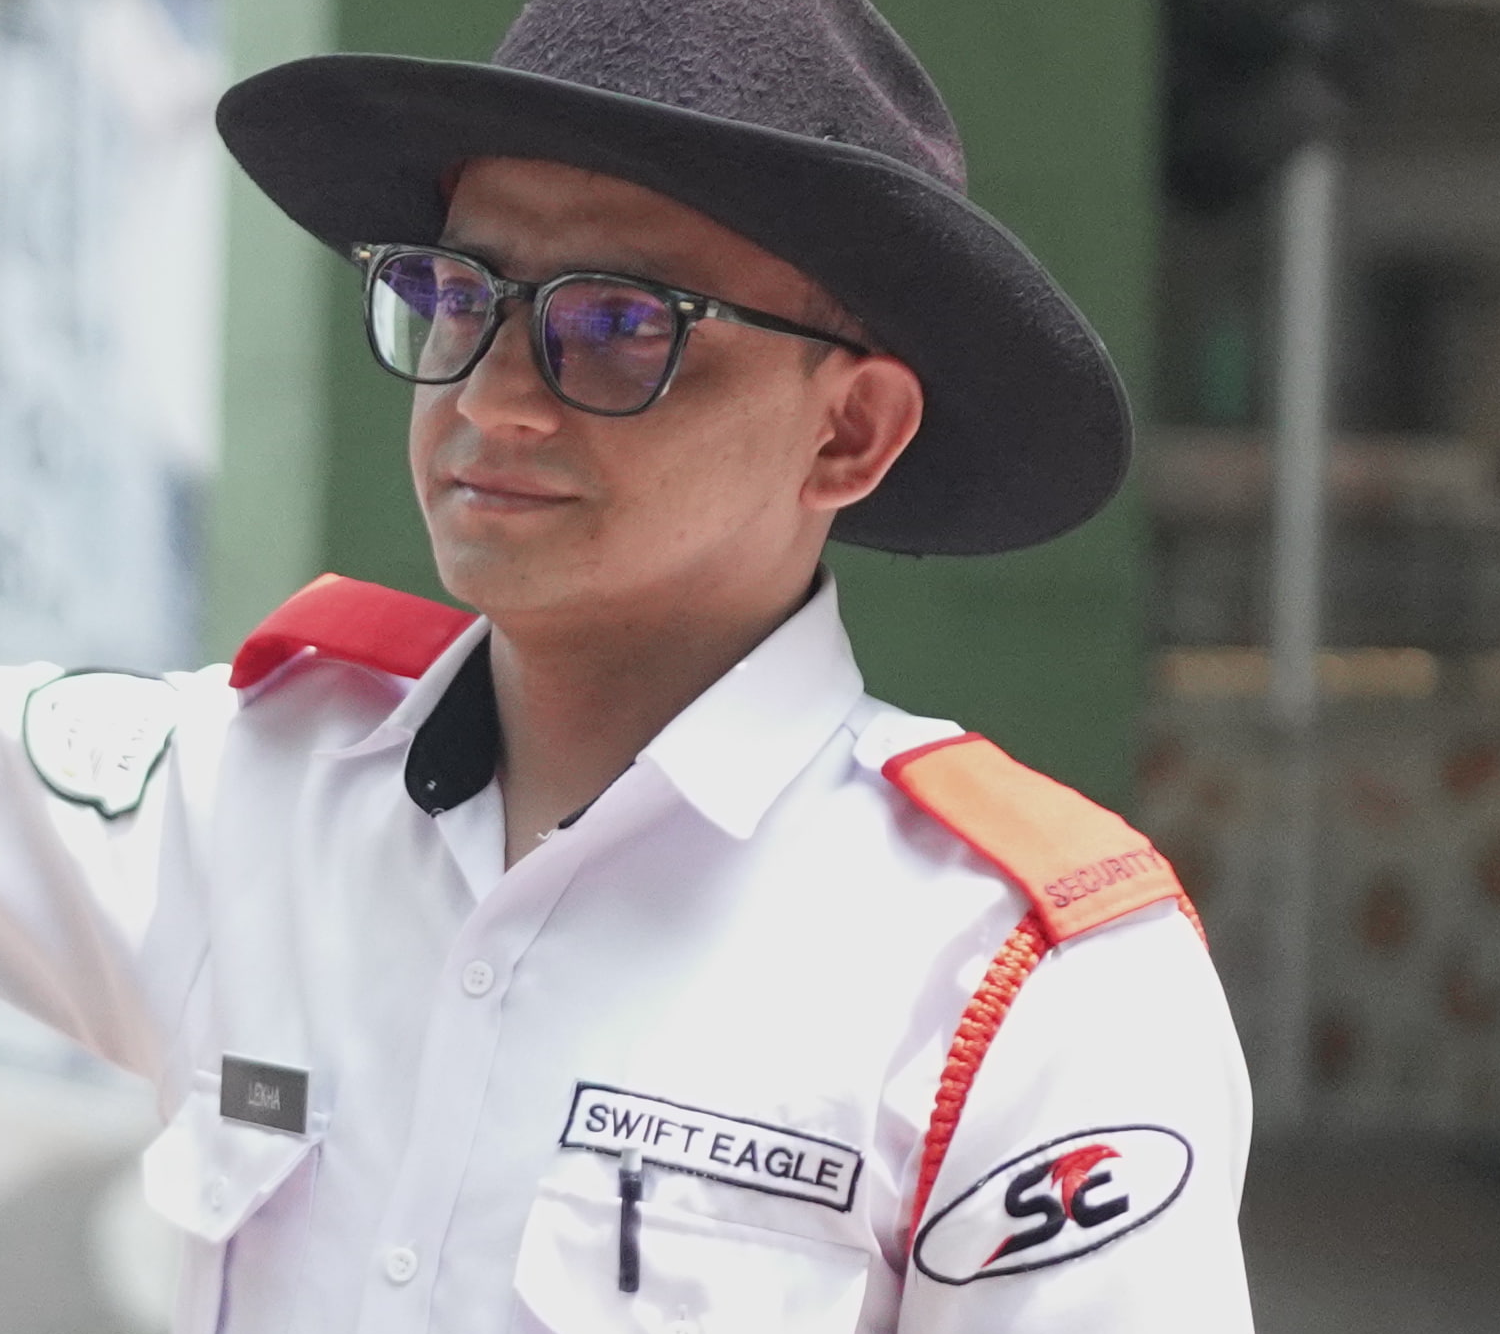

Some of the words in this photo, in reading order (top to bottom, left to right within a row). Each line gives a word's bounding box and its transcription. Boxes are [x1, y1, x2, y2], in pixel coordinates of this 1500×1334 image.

[1044, 848, 1164, 907] SECURITY
[585, 1103, 704, 1153] SWIFT
[708, 1131, 844, 1192] EAGLE
